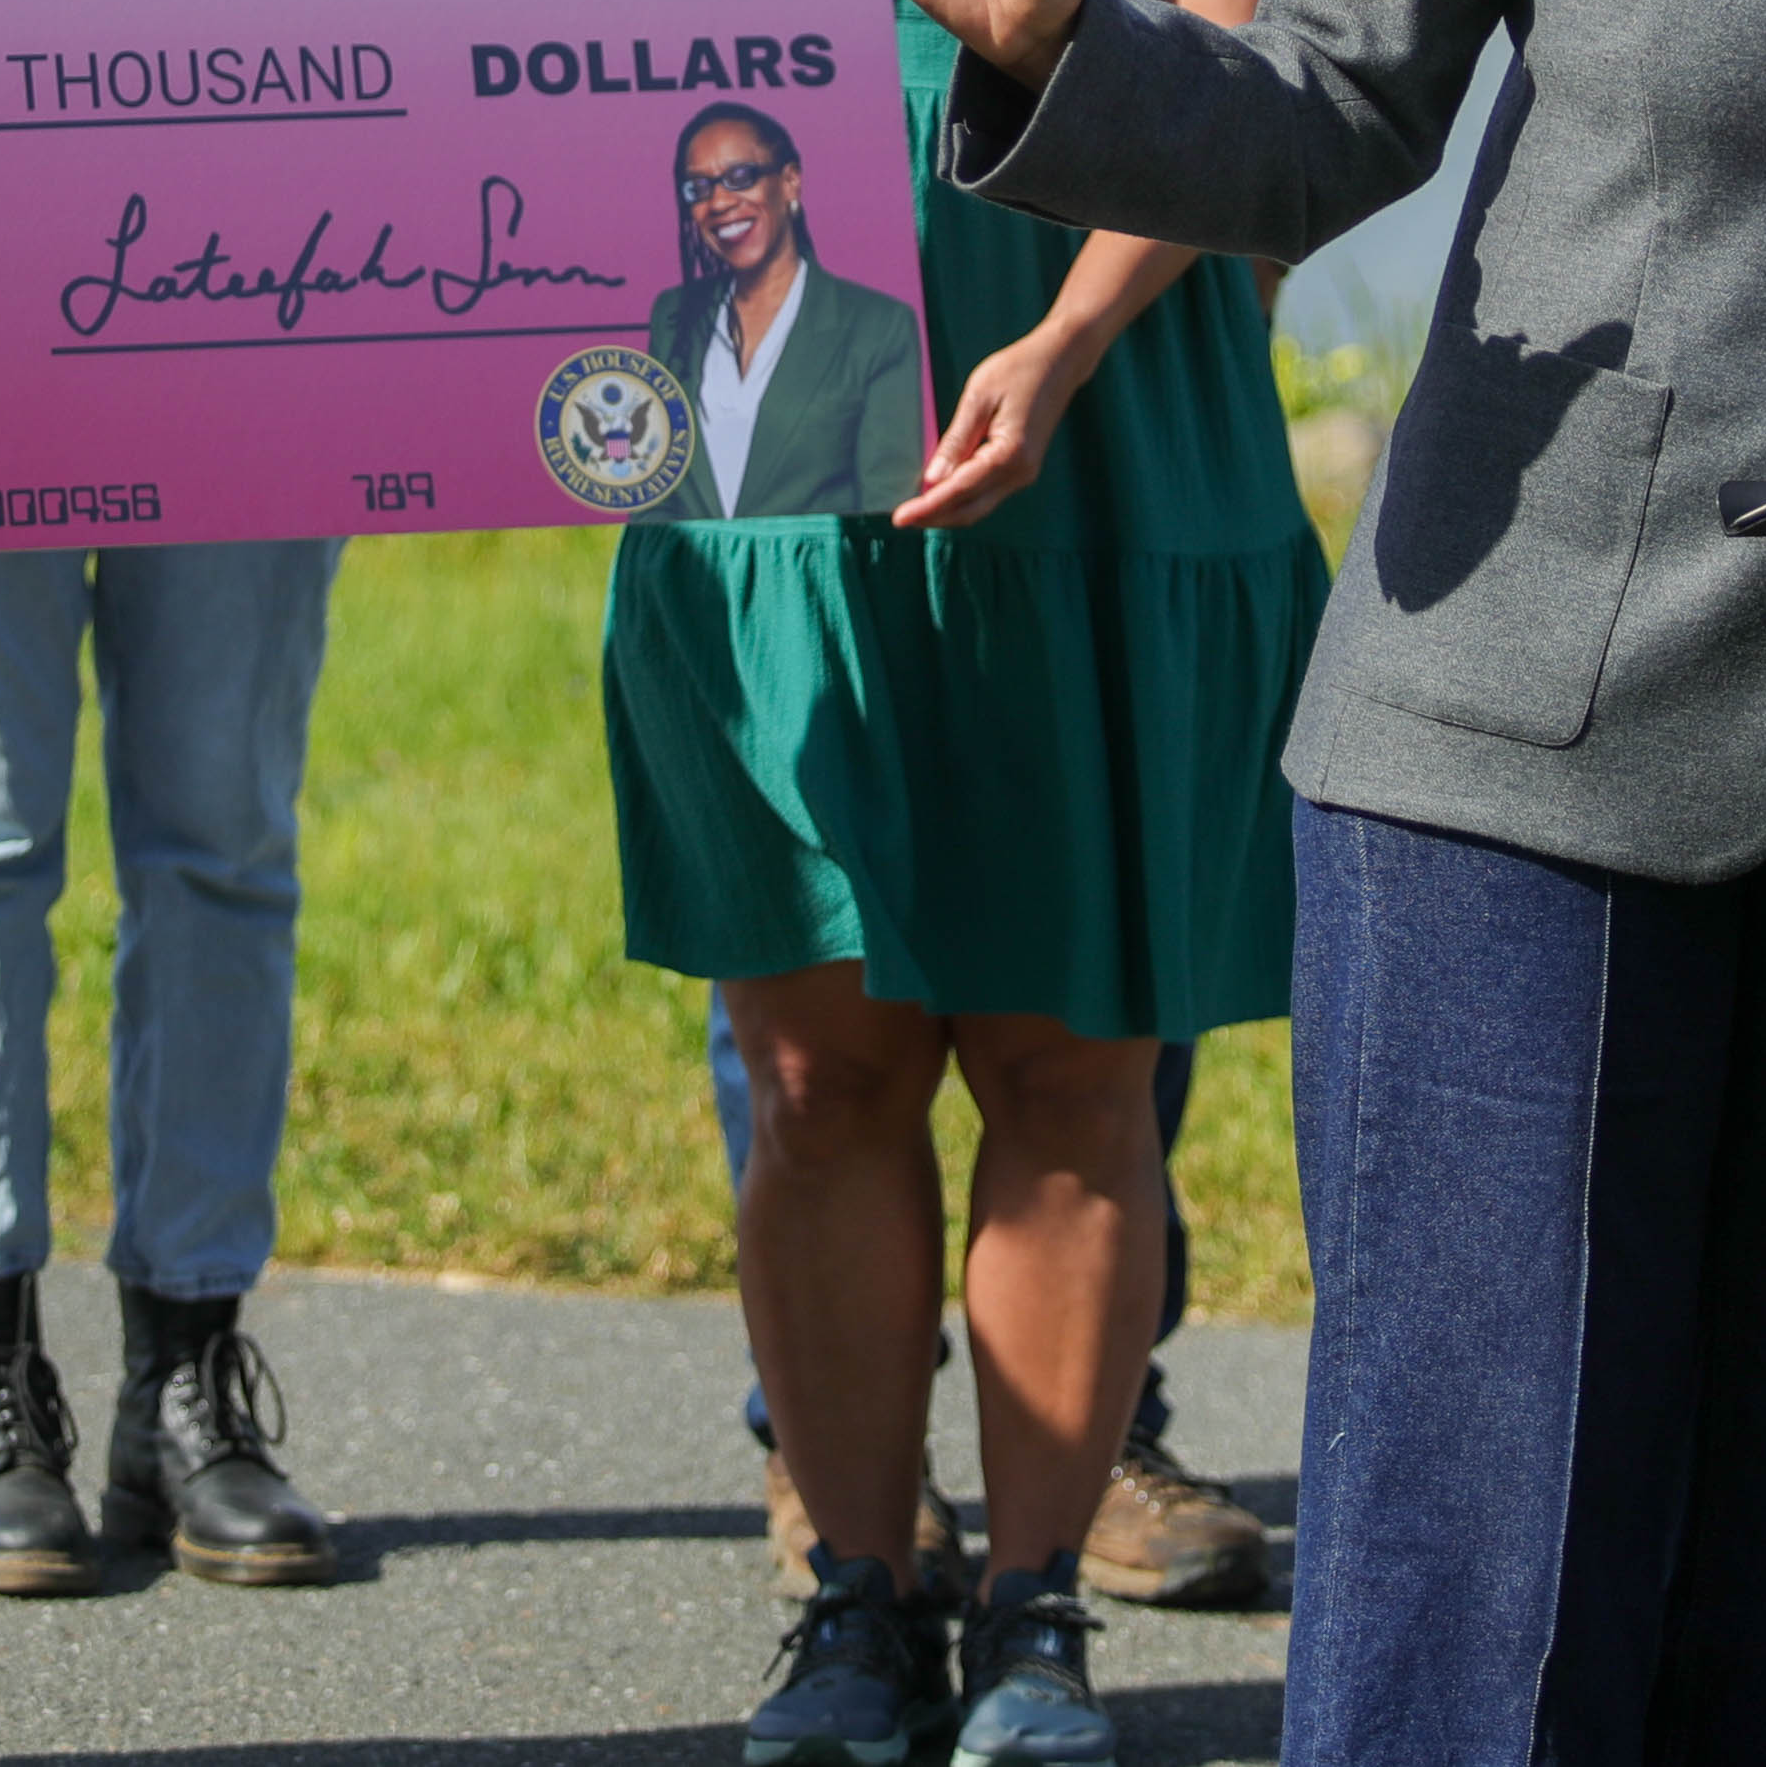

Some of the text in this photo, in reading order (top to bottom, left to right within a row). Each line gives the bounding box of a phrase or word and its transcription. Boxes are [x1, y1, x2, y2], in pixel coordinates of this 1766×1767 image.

[6, 43, 394, 112] THOUSAND
[471, 33, 837, 97] DOLLARS
[350, 471, 437, 512] 789
